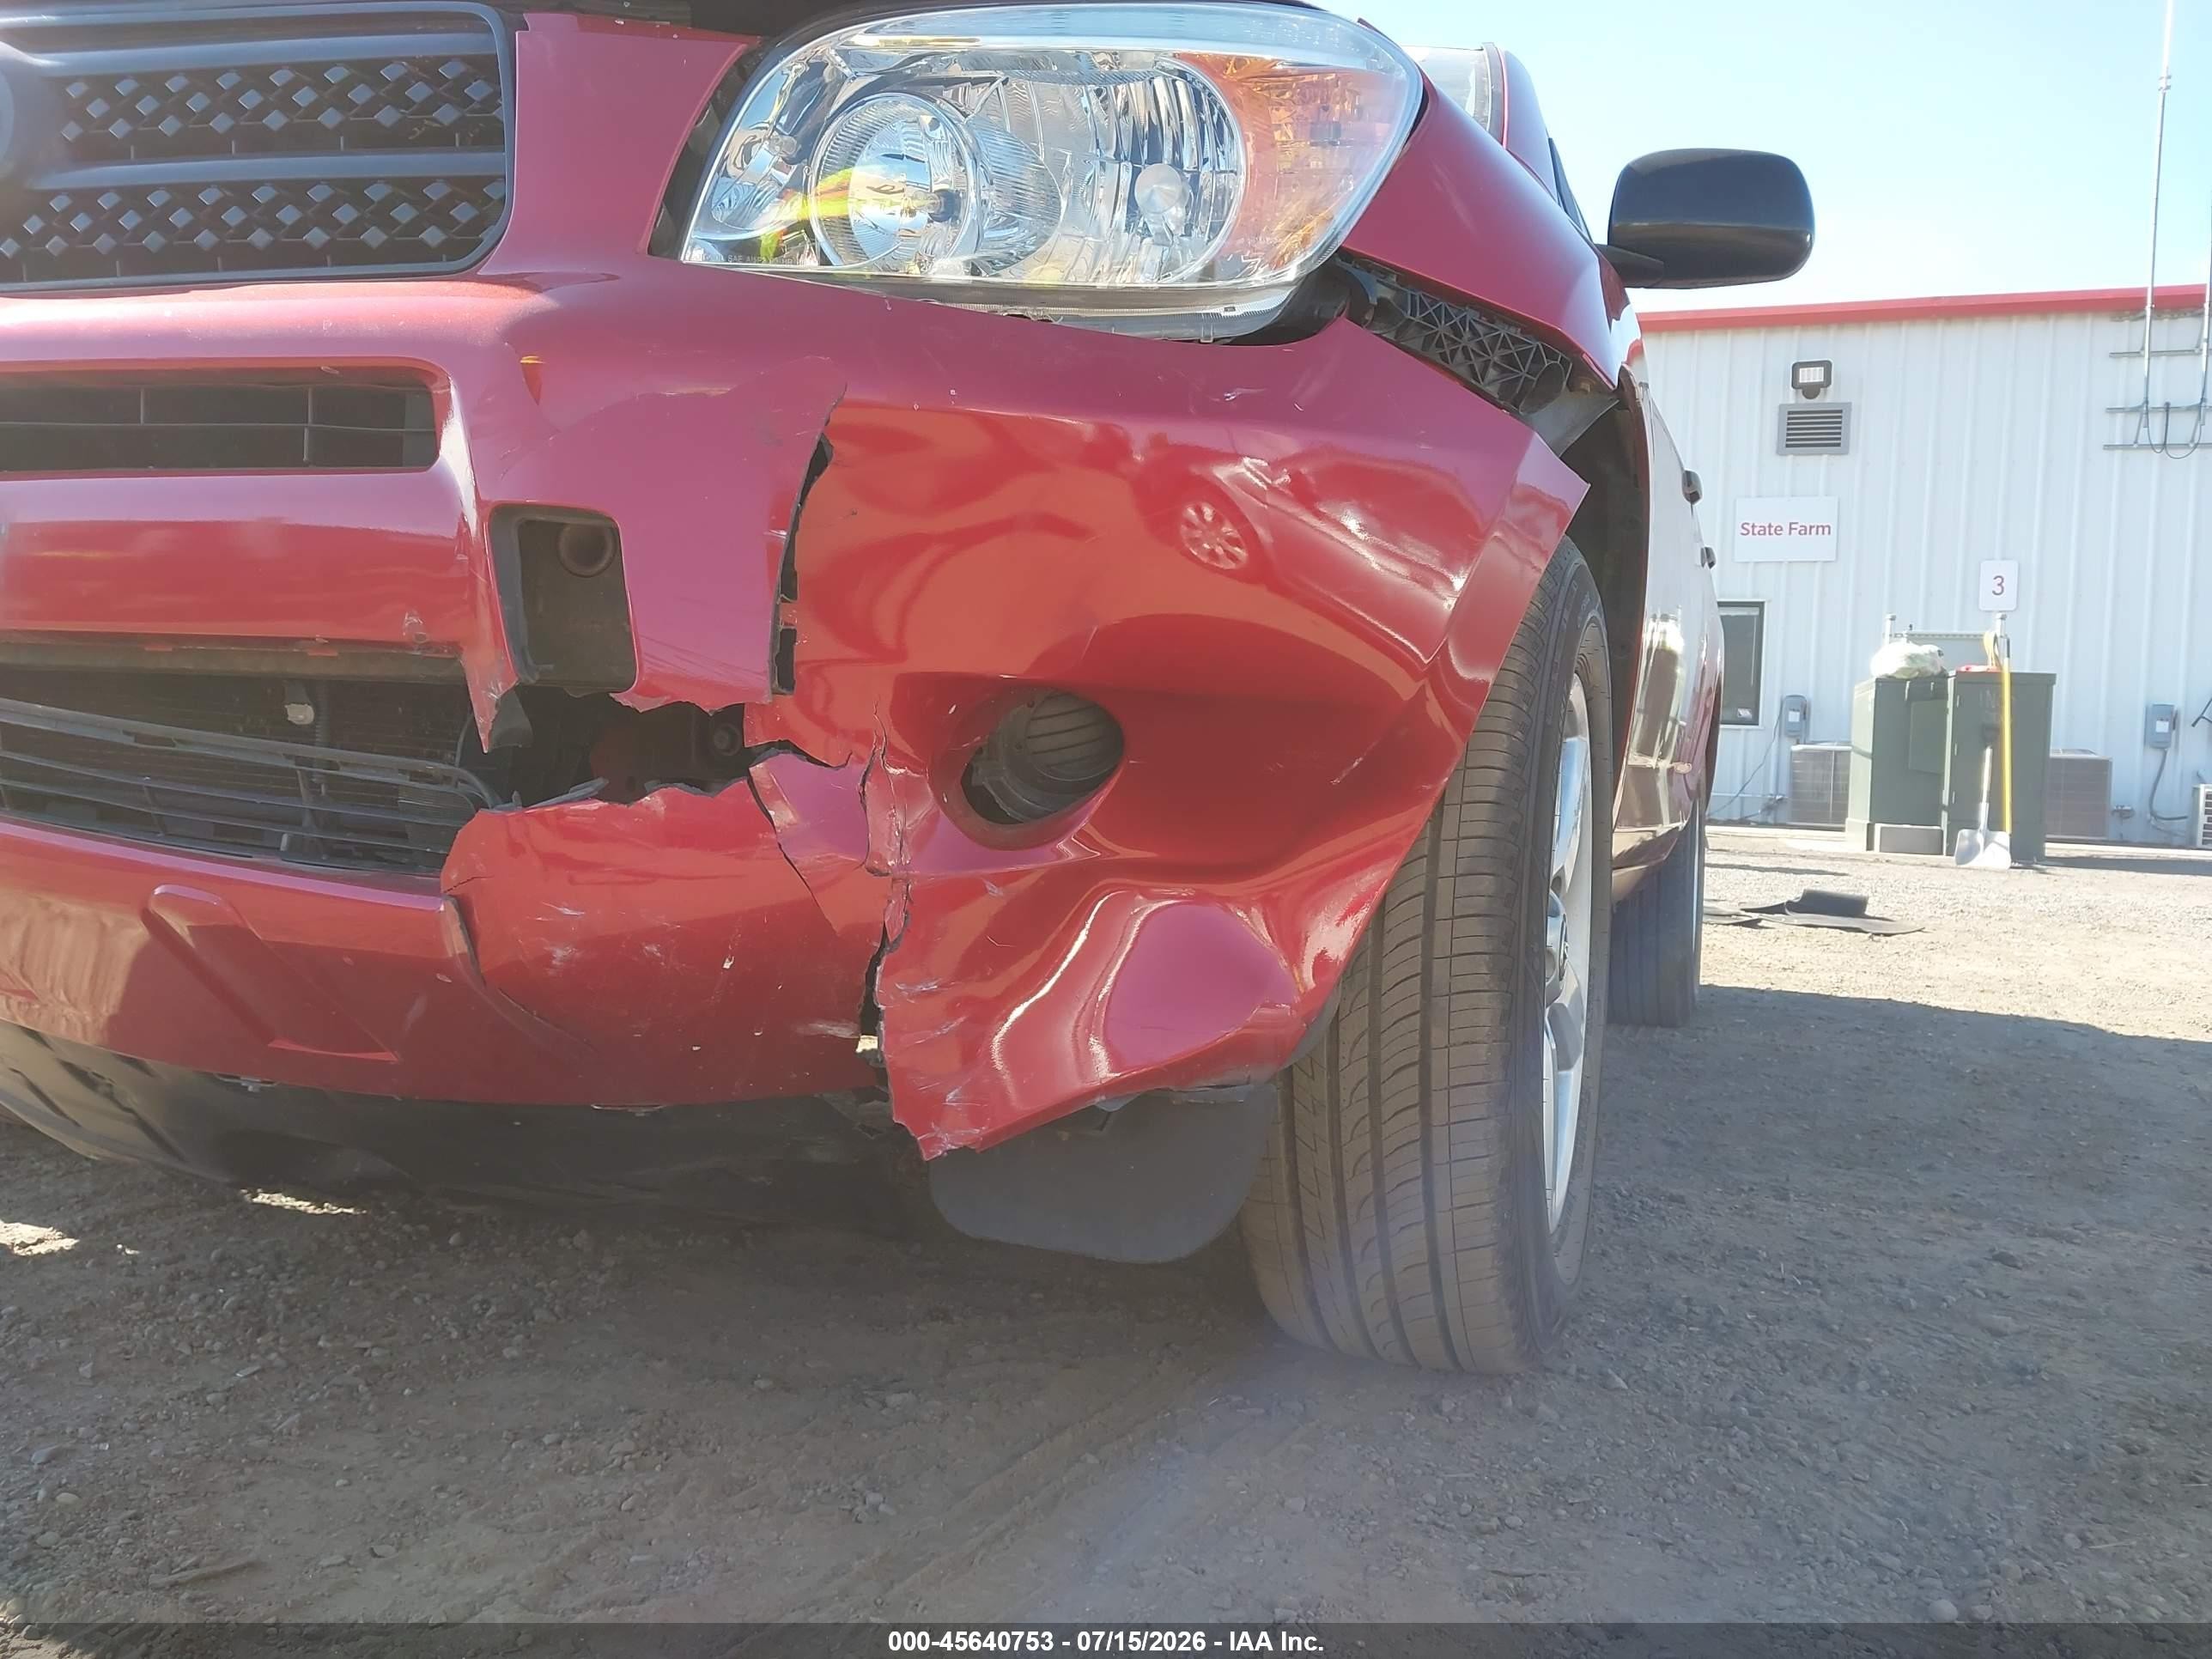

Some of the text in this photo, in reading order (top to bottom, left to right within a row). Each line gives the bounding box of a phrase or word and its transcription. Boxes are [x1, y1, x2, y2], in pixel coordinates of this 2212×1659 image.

[1740, 521, 1832, 536] State Farm
[1991, 574, 2005, 596] 3
